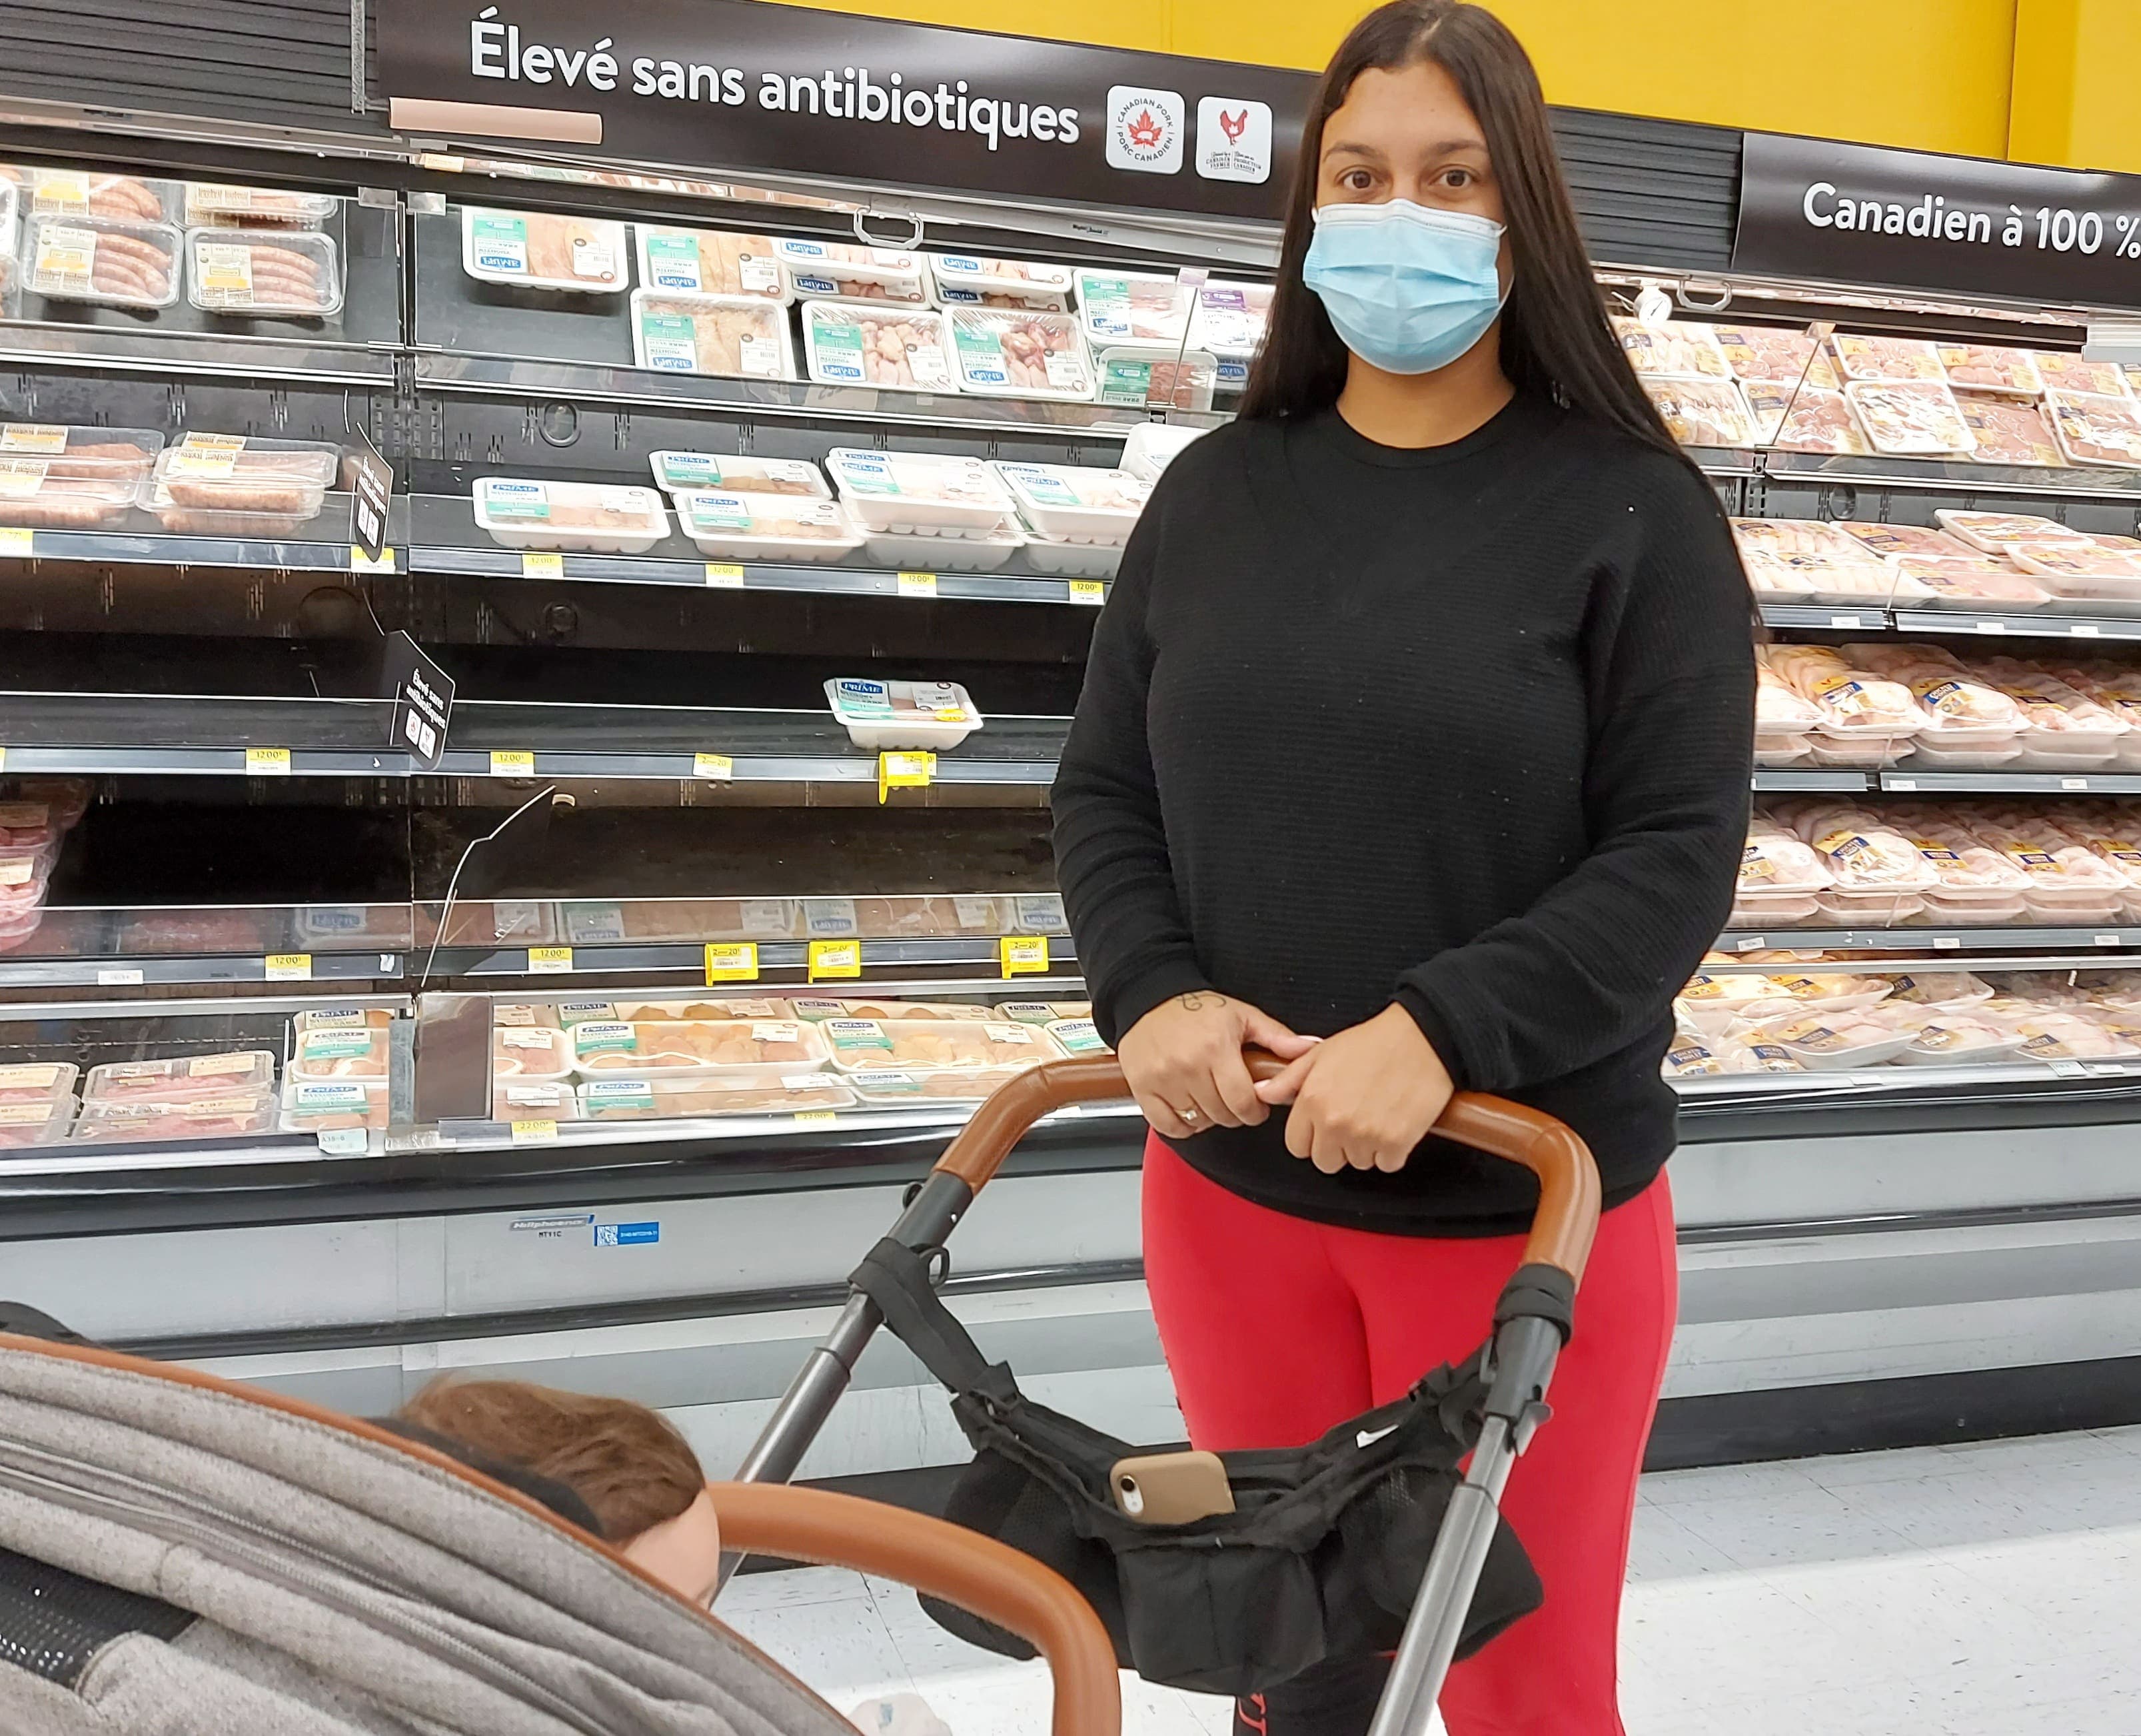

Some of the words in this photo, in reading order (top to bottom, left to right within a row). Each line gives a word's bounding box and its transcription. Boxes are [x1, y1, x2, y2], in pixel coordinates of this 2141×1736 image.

[471, 6, 619, 91] Élevé
[632, 57, 746, 106] sans
[758, 67, 1080, 151] antibiotiques
[1118, 99, 1155, 123] CANADIAN
[1156, 103, 1173, 128] PORK
[1117, 131, 1133, 156] PORC
[1134, 137, 1173, 162] CANADIEN
[1803, 181, 1991, 243] Canadien
[2002, 203, 2023, 247] à
[2036, 207, 2104, 255] 100
[2115, 215, 2141, 259] %
[843, 682, 881, 694] PRIME
